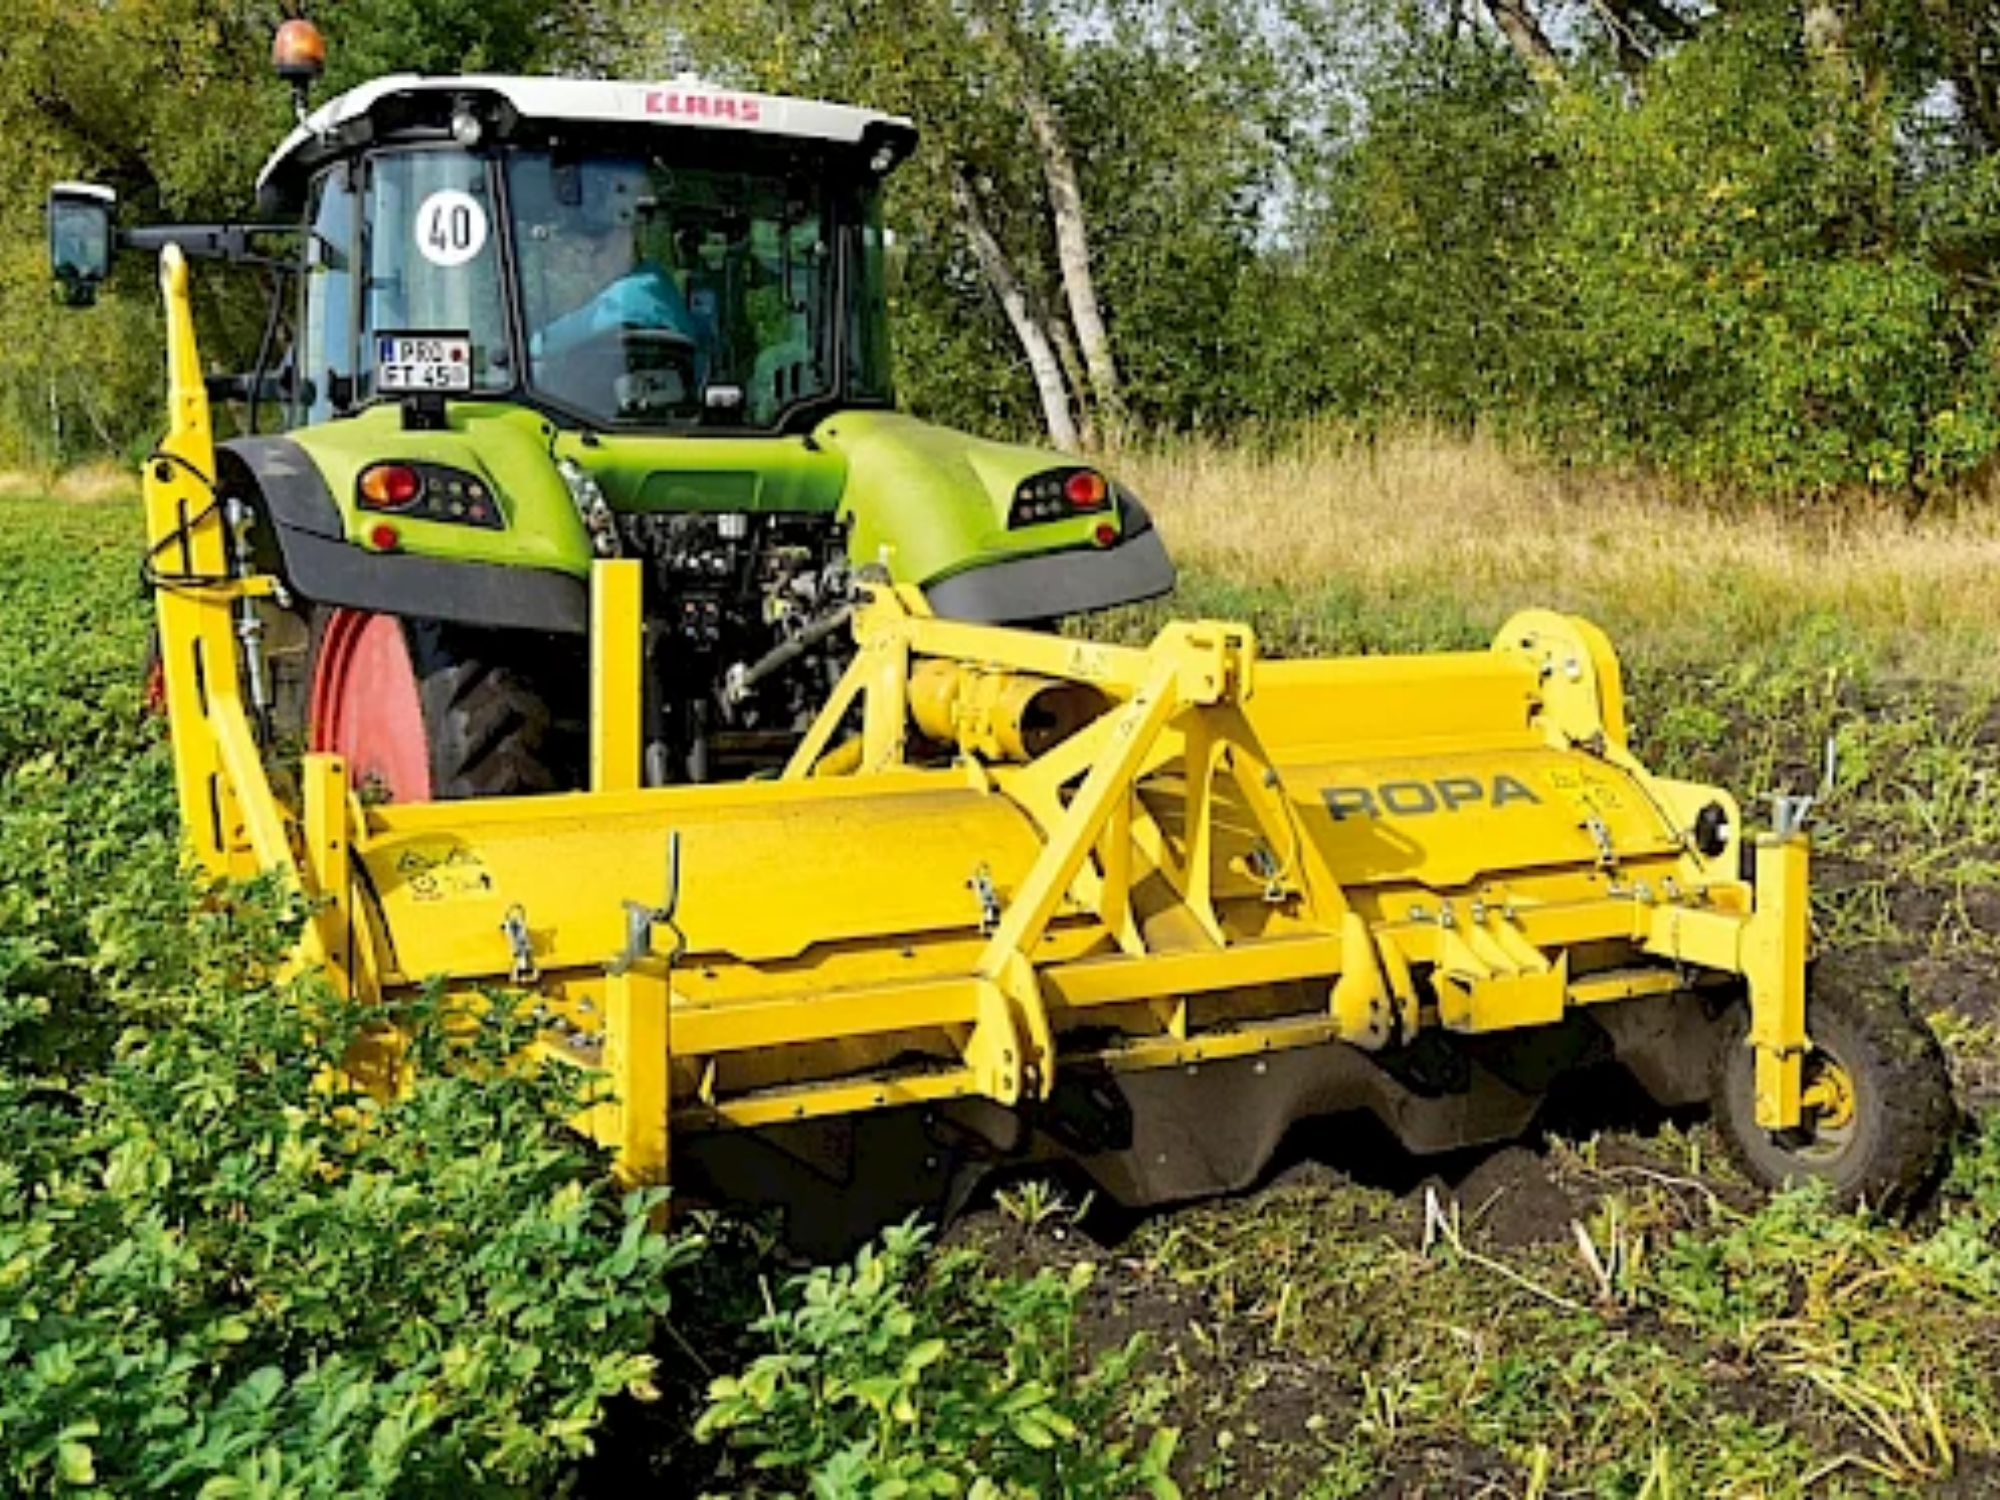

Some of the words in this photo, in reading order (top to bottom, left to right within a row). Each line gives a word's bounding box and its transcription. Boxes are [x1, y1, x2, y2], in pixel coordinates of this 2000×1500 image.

[645, 92, 760, 121] CLAAS
[428, 204, 470, 252] 40
[1321, 774, 1541, 821] ROPA
